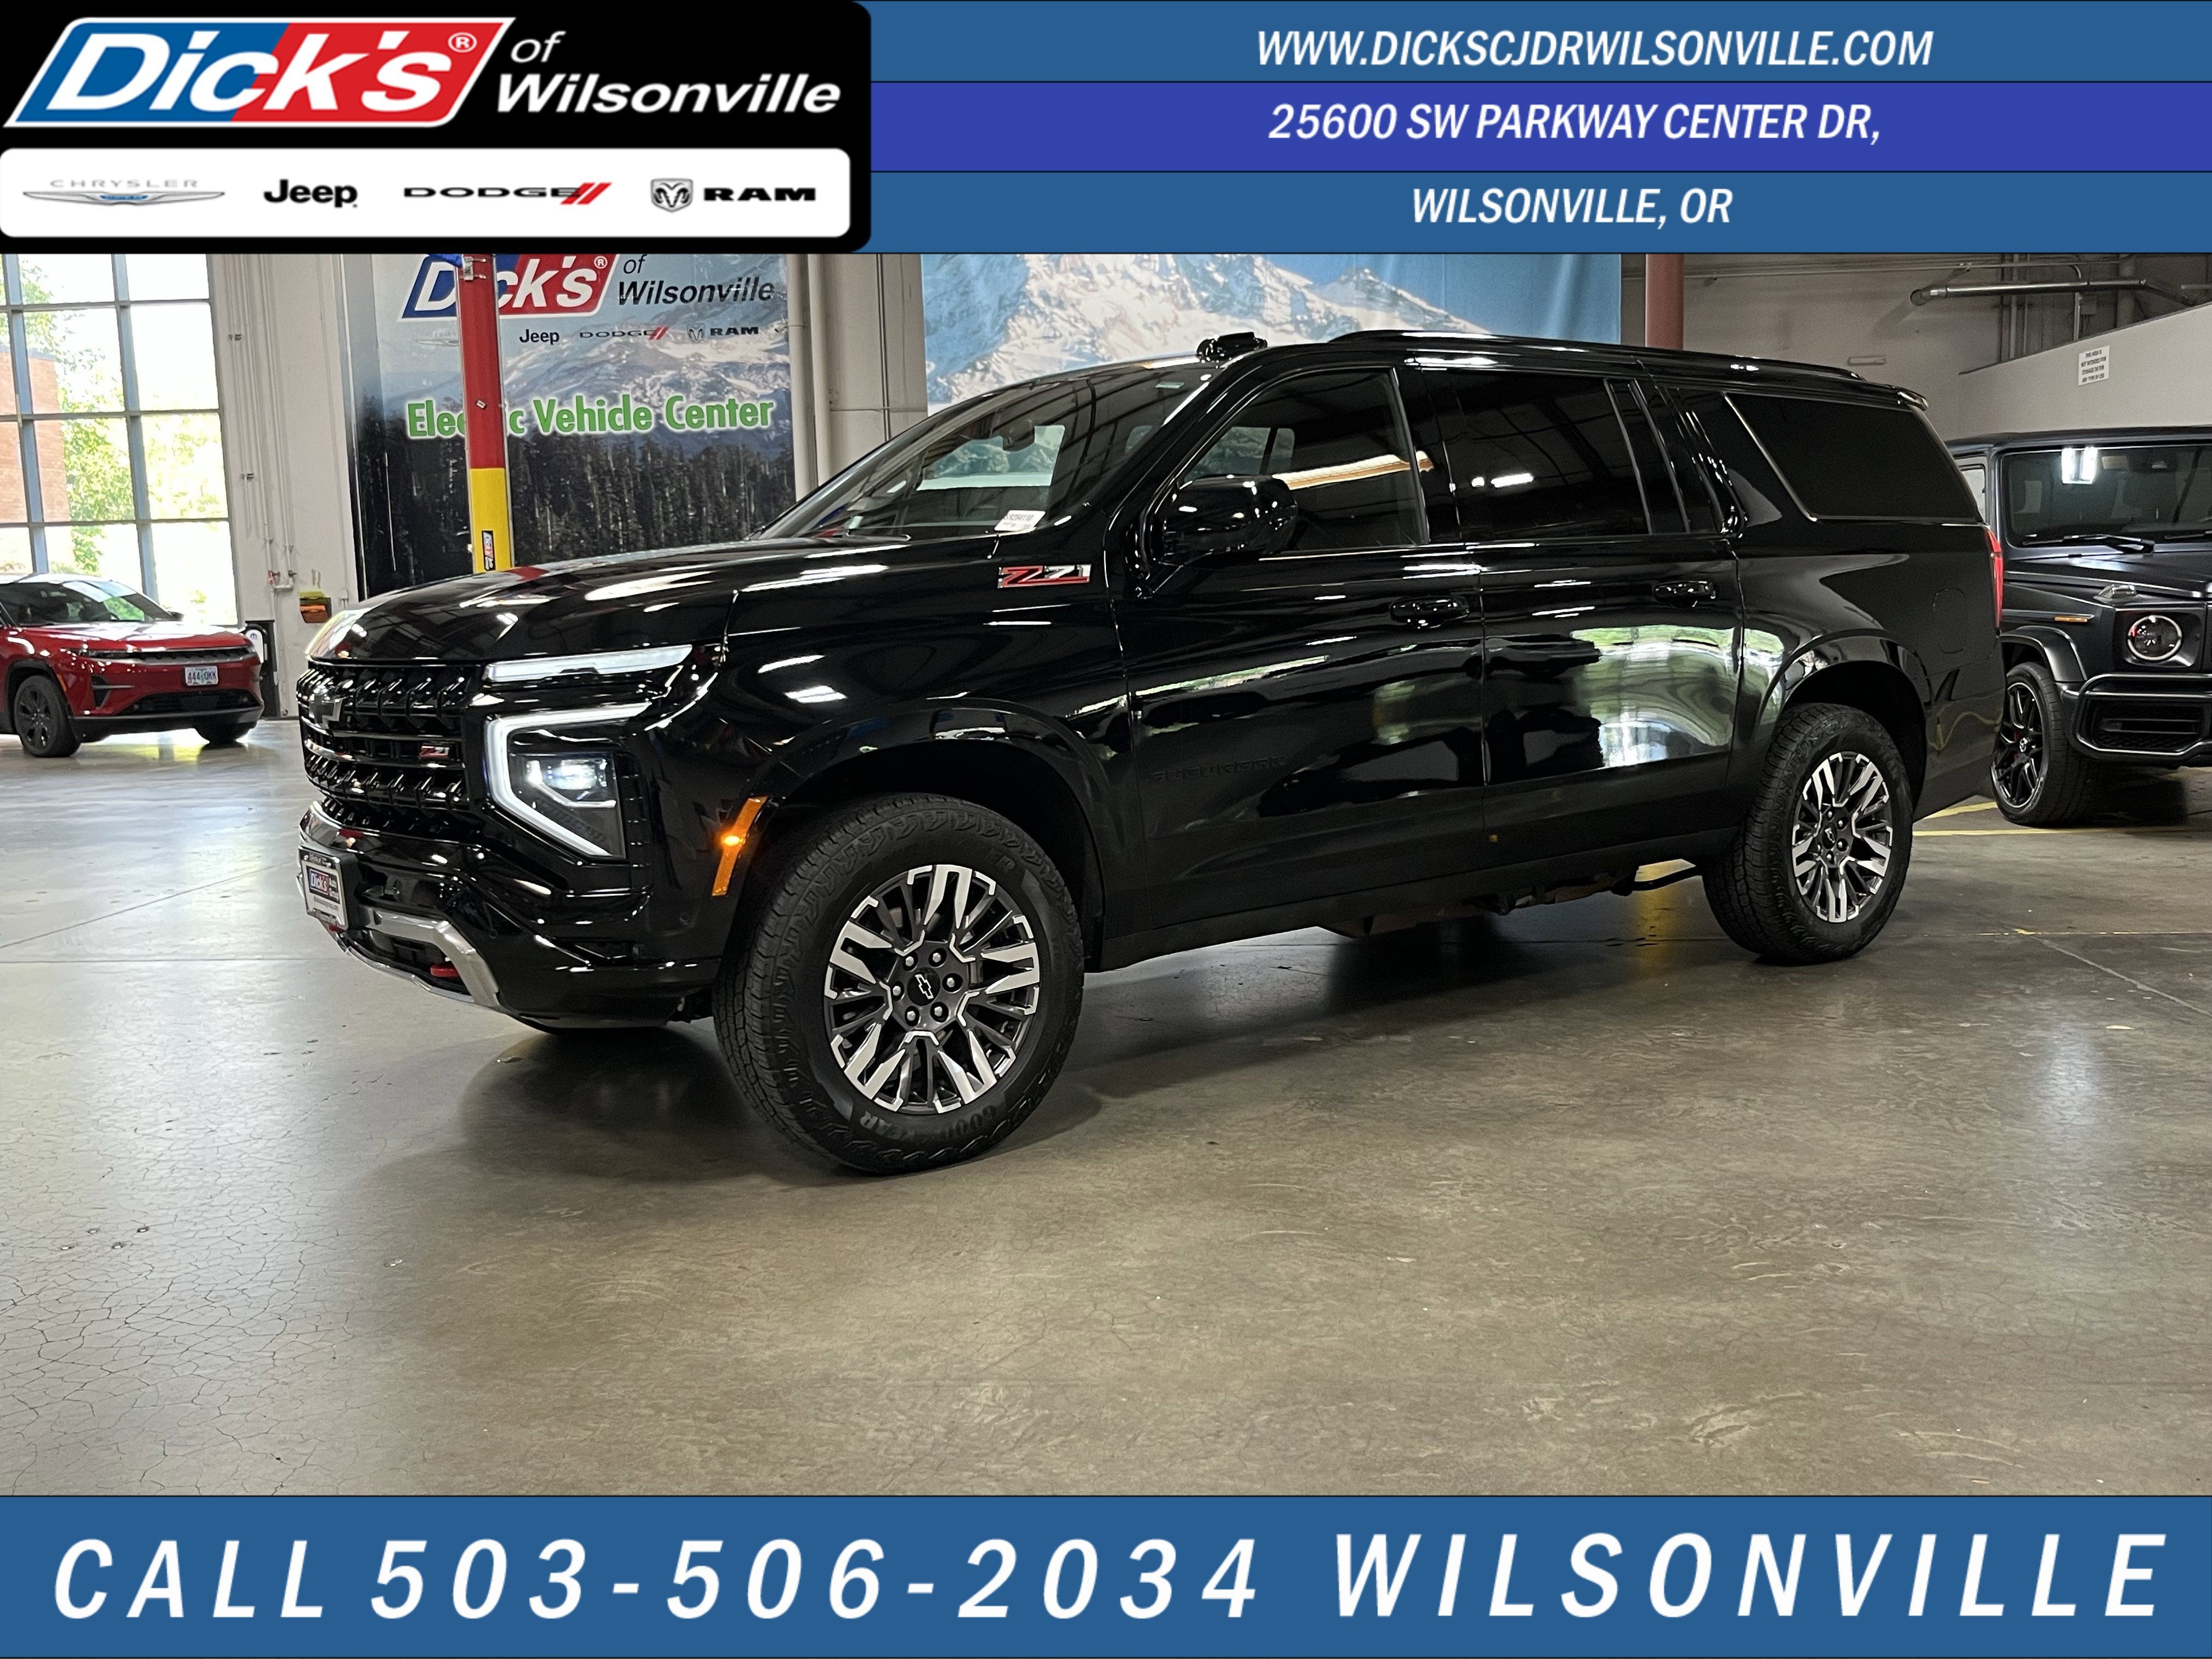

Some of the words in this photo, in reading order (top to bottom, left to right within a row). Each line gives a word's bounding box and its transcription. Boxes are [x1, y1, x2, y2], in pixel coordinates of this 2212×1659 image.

[414, 256, 597, 311] Dck's
[623, 254, 647, 274] of
[619, 276, 775, 305] Wilsonville
[519, 329, 560, 345] Jeep
[710, 327, 759, 336] RAM
[408, 400, 525, 436] Elecc
[533, 394, 652, 433] Vehicle
[665, 396, 774, 430] Center
[997, 564, 1092, 589] Z71
